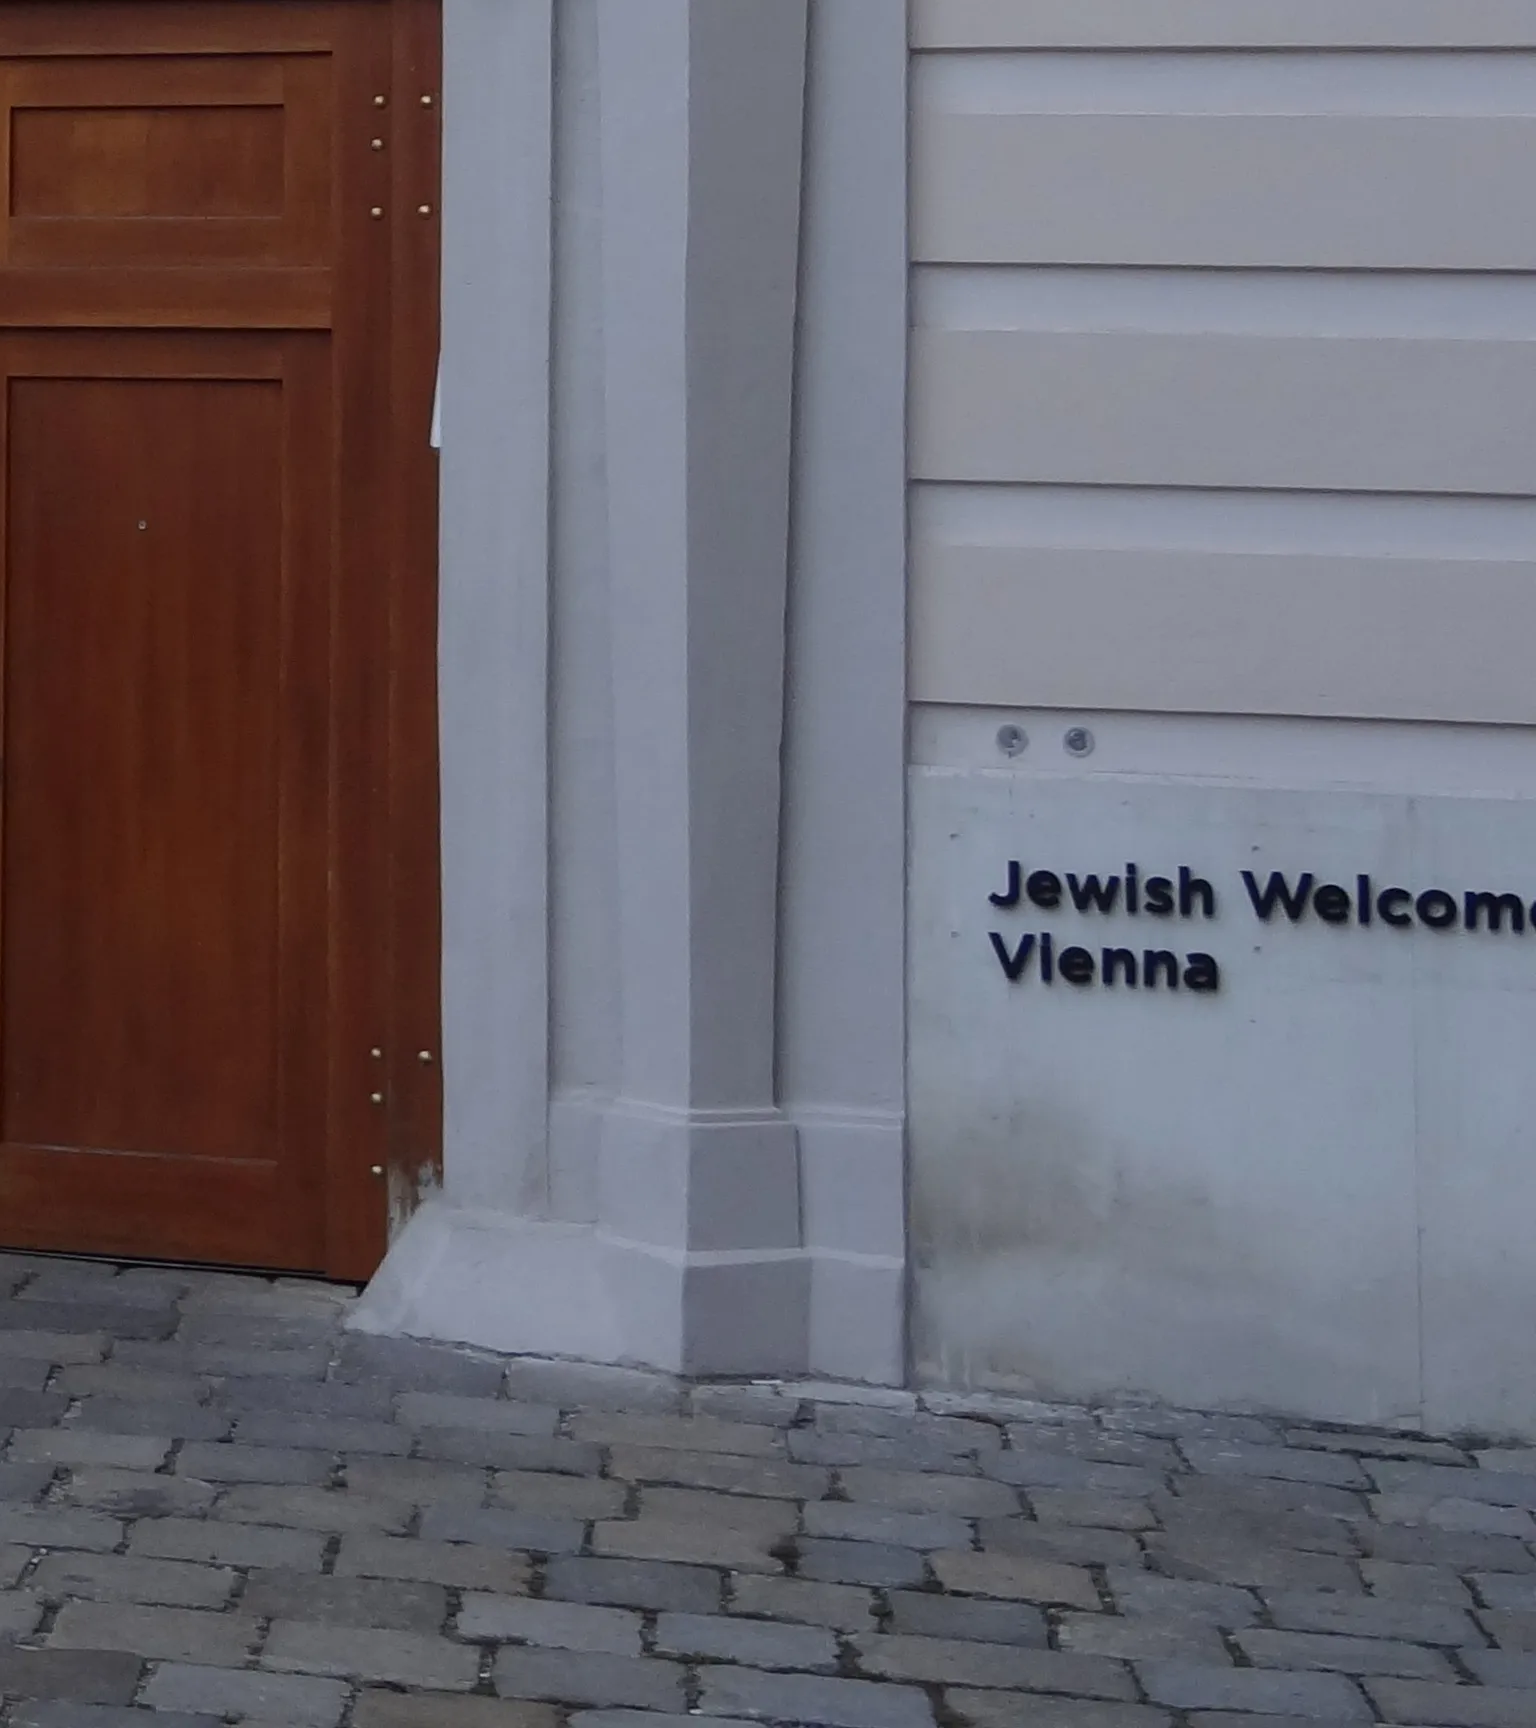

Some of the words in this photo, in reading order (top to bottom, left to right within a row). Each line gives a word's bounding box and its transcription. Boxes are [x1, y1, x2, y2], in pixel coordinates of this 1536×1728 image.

[988, 860, 1216, 921] Jewish
[1239, 870, 1536, 938] Welcom
[988, 931, 1220, 995] Vienna
